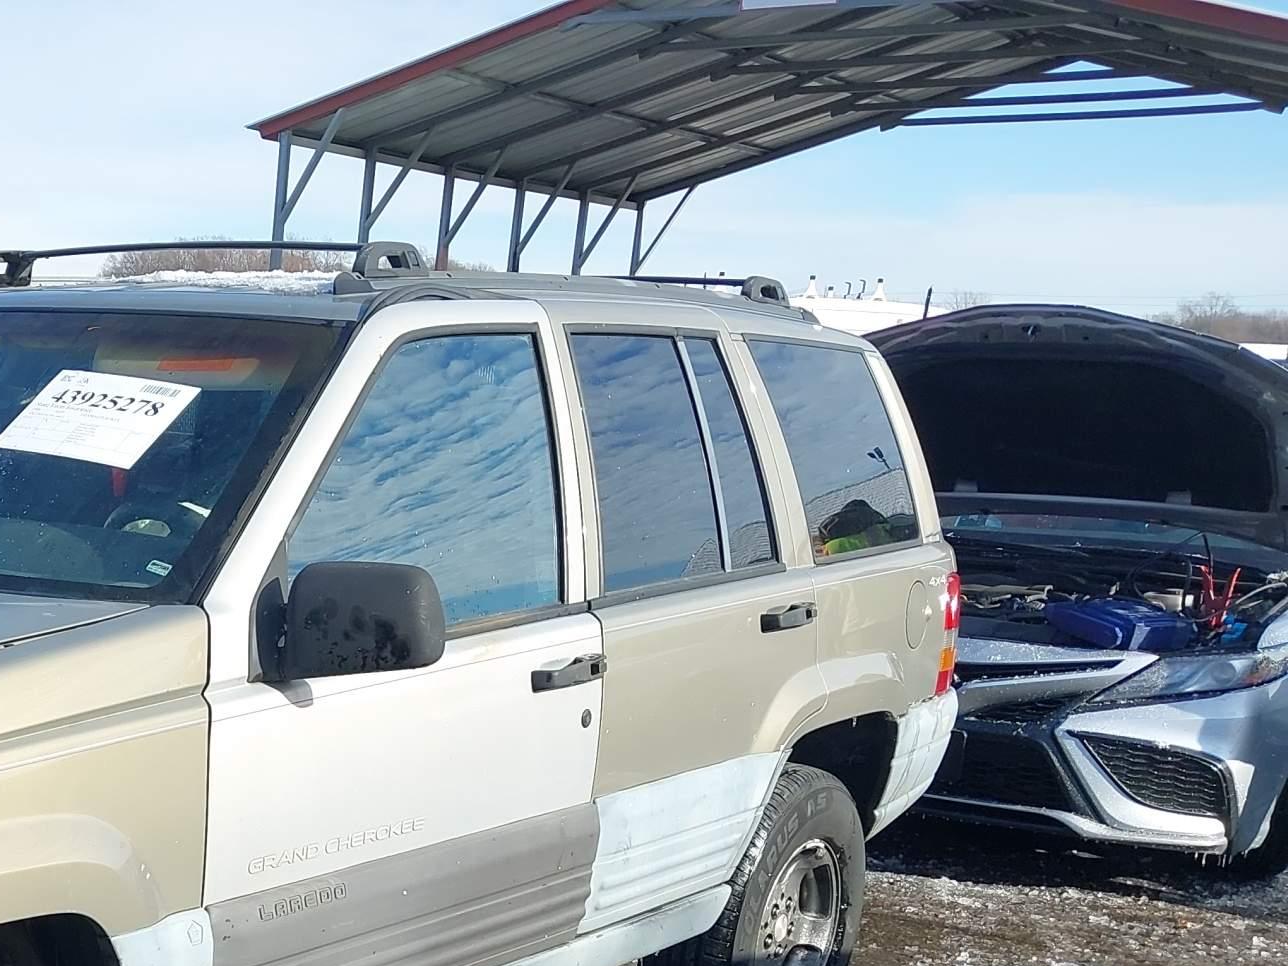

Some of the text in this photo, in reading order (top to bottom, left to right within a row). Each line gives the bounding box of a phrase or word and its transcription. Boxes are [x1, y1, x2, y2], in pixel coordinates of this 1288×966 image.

[52, 389, 164, 416] 43925278
[247, 817, 426, 876] GRAND CHEROKEE
[258, 882, 348, 922] LAREDO
